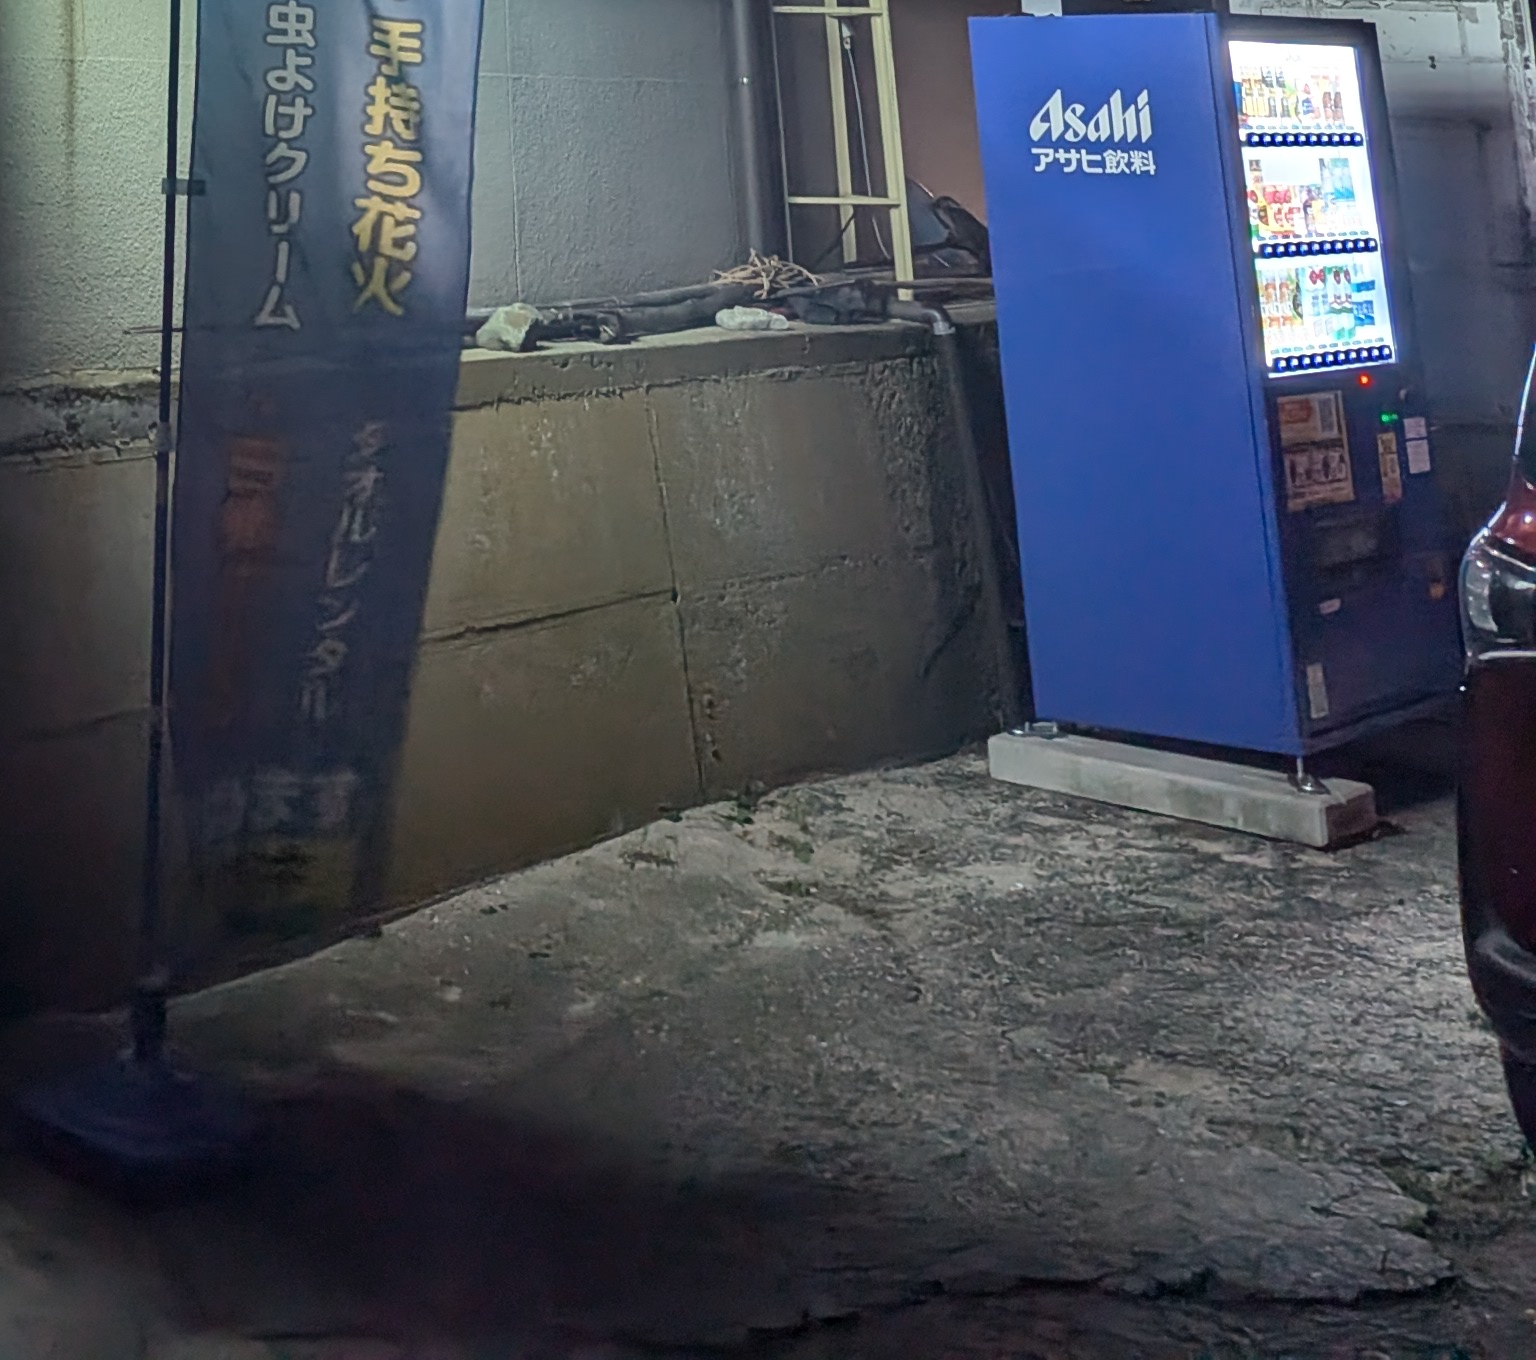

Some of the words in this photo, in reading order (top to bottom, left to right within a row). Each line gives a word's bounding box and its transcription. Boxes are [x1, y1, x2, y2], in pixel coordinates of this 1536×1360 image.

[1029, 88, 1153, 143] Asahi
[1030, 147, 1157, 176] アサヒ飲料
